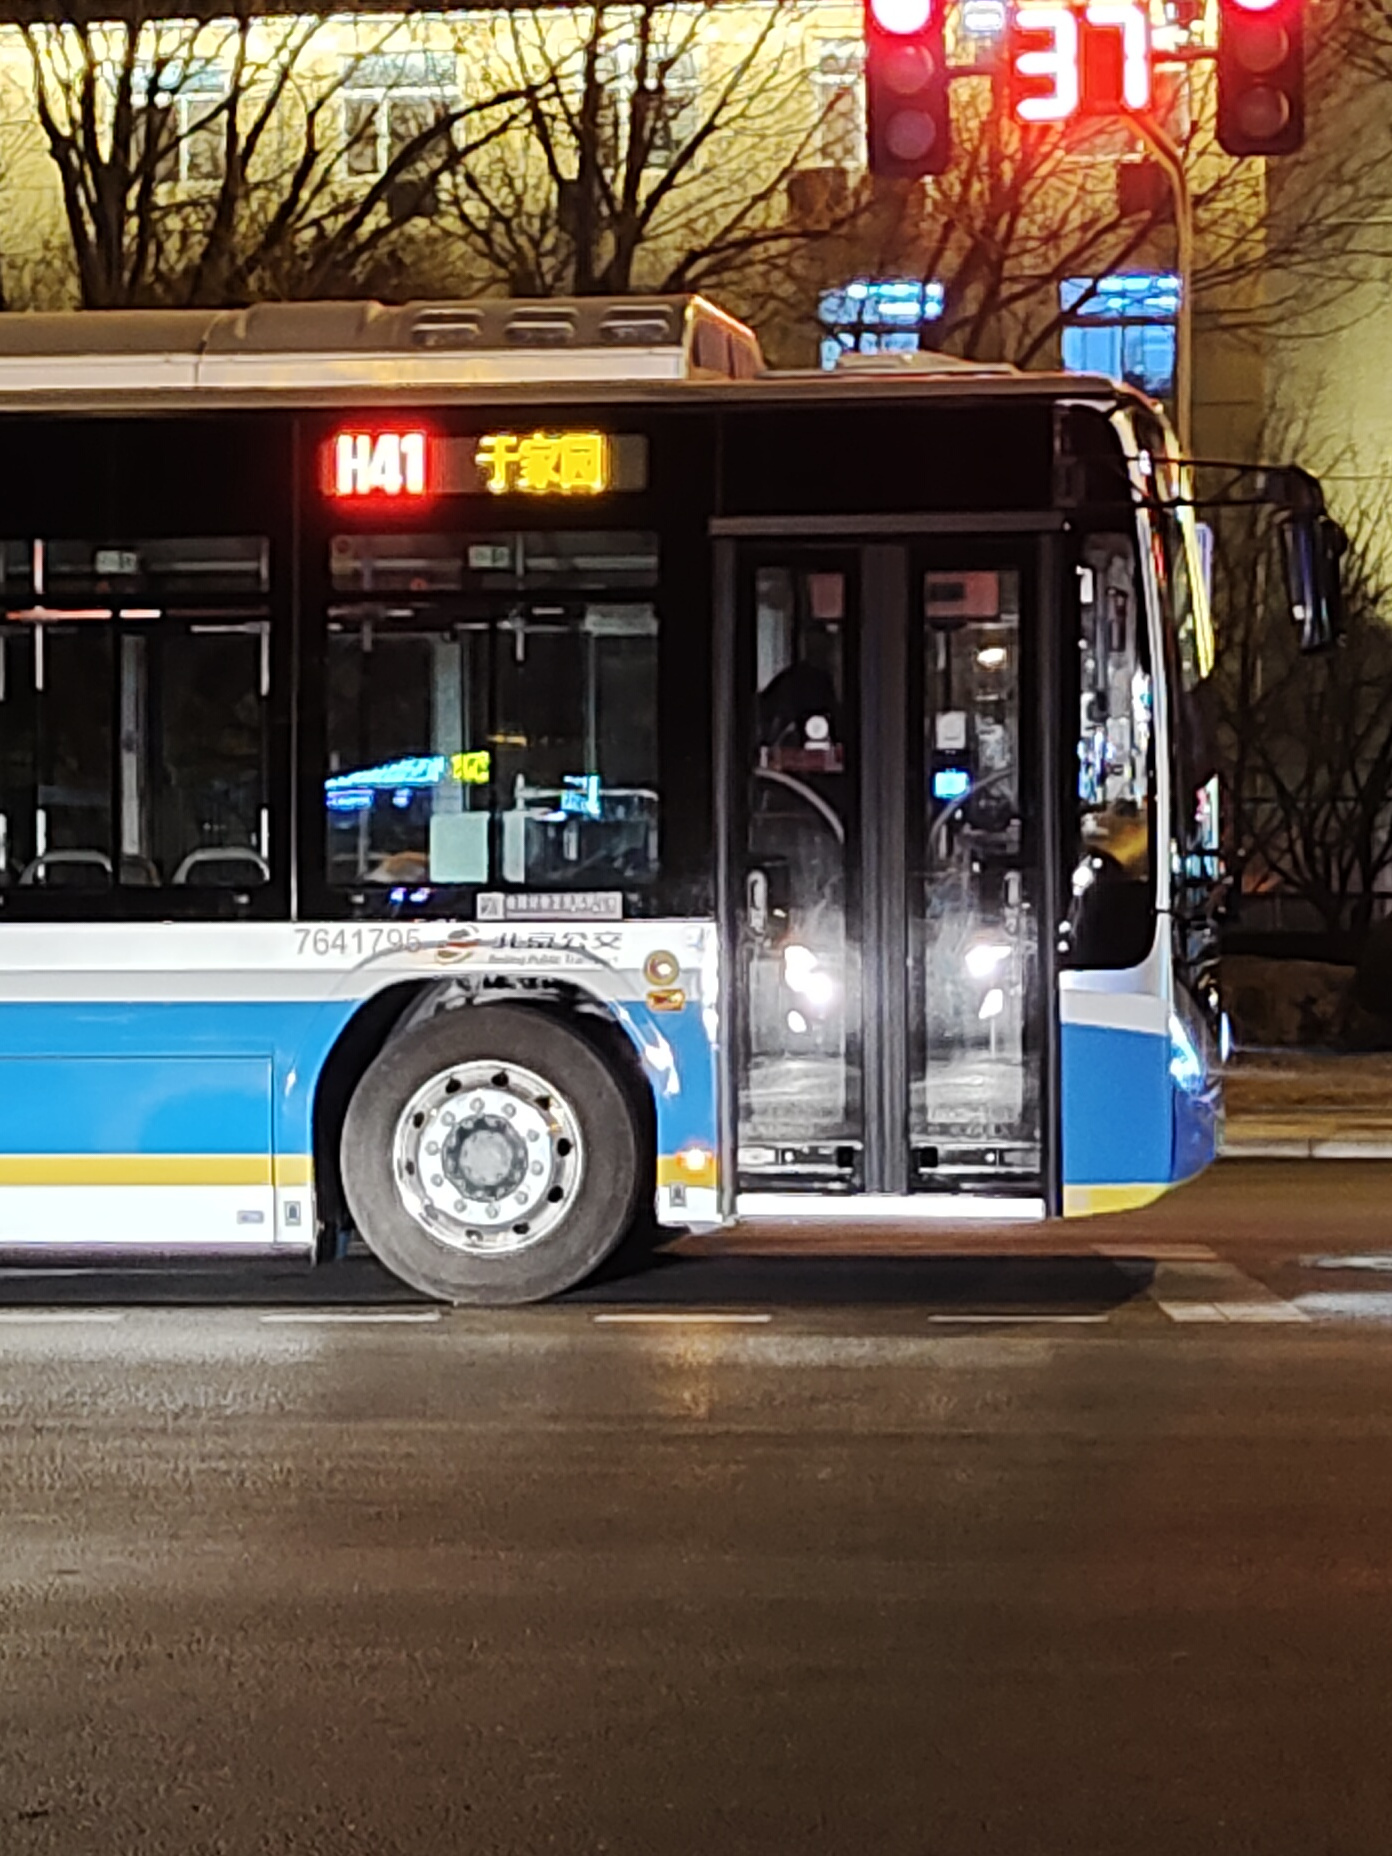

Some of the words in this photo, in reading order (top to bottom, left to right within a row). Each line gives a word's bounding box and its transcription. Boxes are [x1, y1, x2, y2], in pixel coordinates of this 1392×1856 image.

[1015, 5, 1150, 122] 37
[336, 433, 426, 494] H41
[294, 927, 422, 955] 7641795
[492, 930, 623, 951] 北京公交
